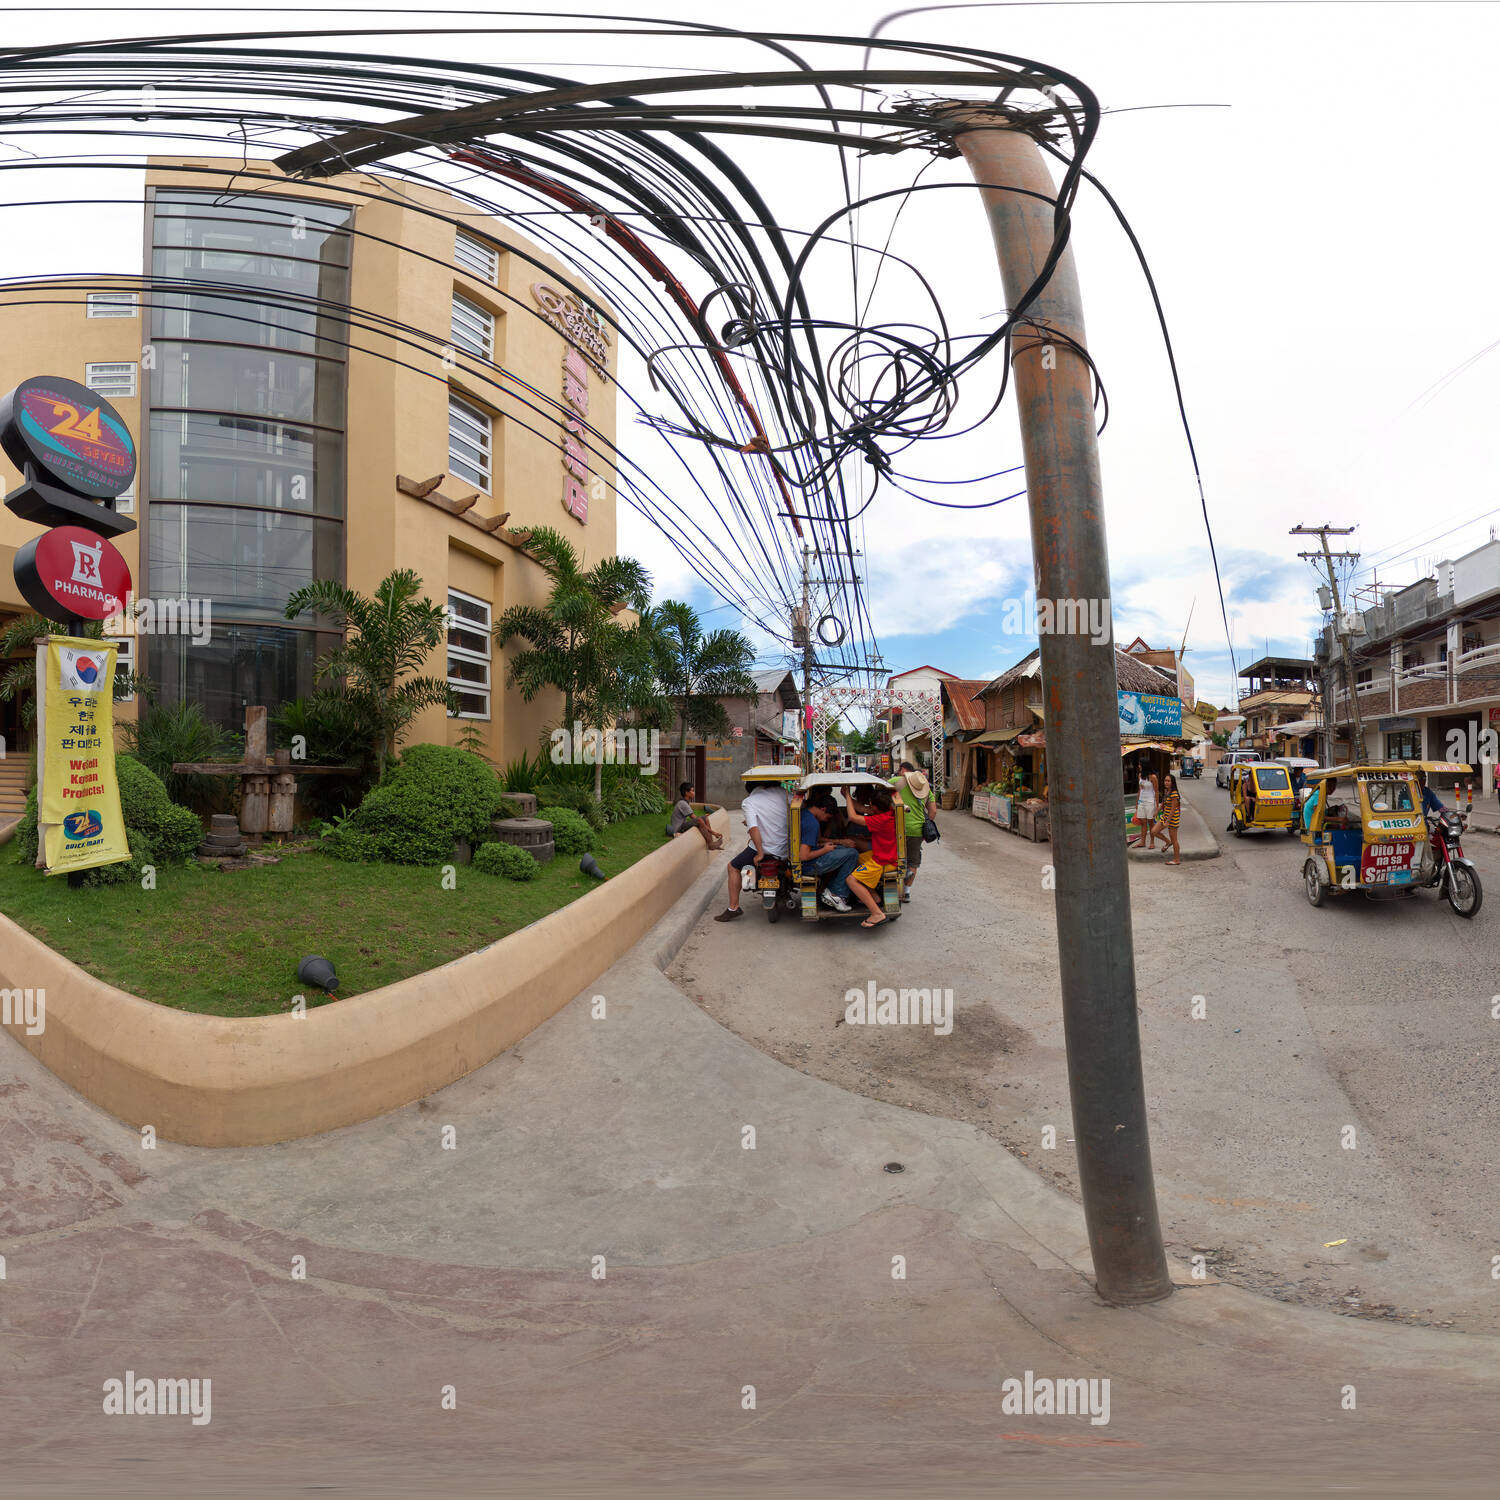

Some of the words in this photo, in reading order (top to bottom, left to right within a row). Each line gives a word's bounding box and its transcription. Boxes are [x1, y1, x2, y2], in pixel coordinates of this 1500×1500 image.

[49, 404, 102, 441] 24
[55, 579, 120, 605] PHARMACY
[1357, 771, 1400, 781] FIREFLY
[1370, 844, 1394, 857] Dito
[1395, 843, 1410, 855] ka
[1376, 857, 1390, 866] na
[1390, 855, 1403, 865] sa
